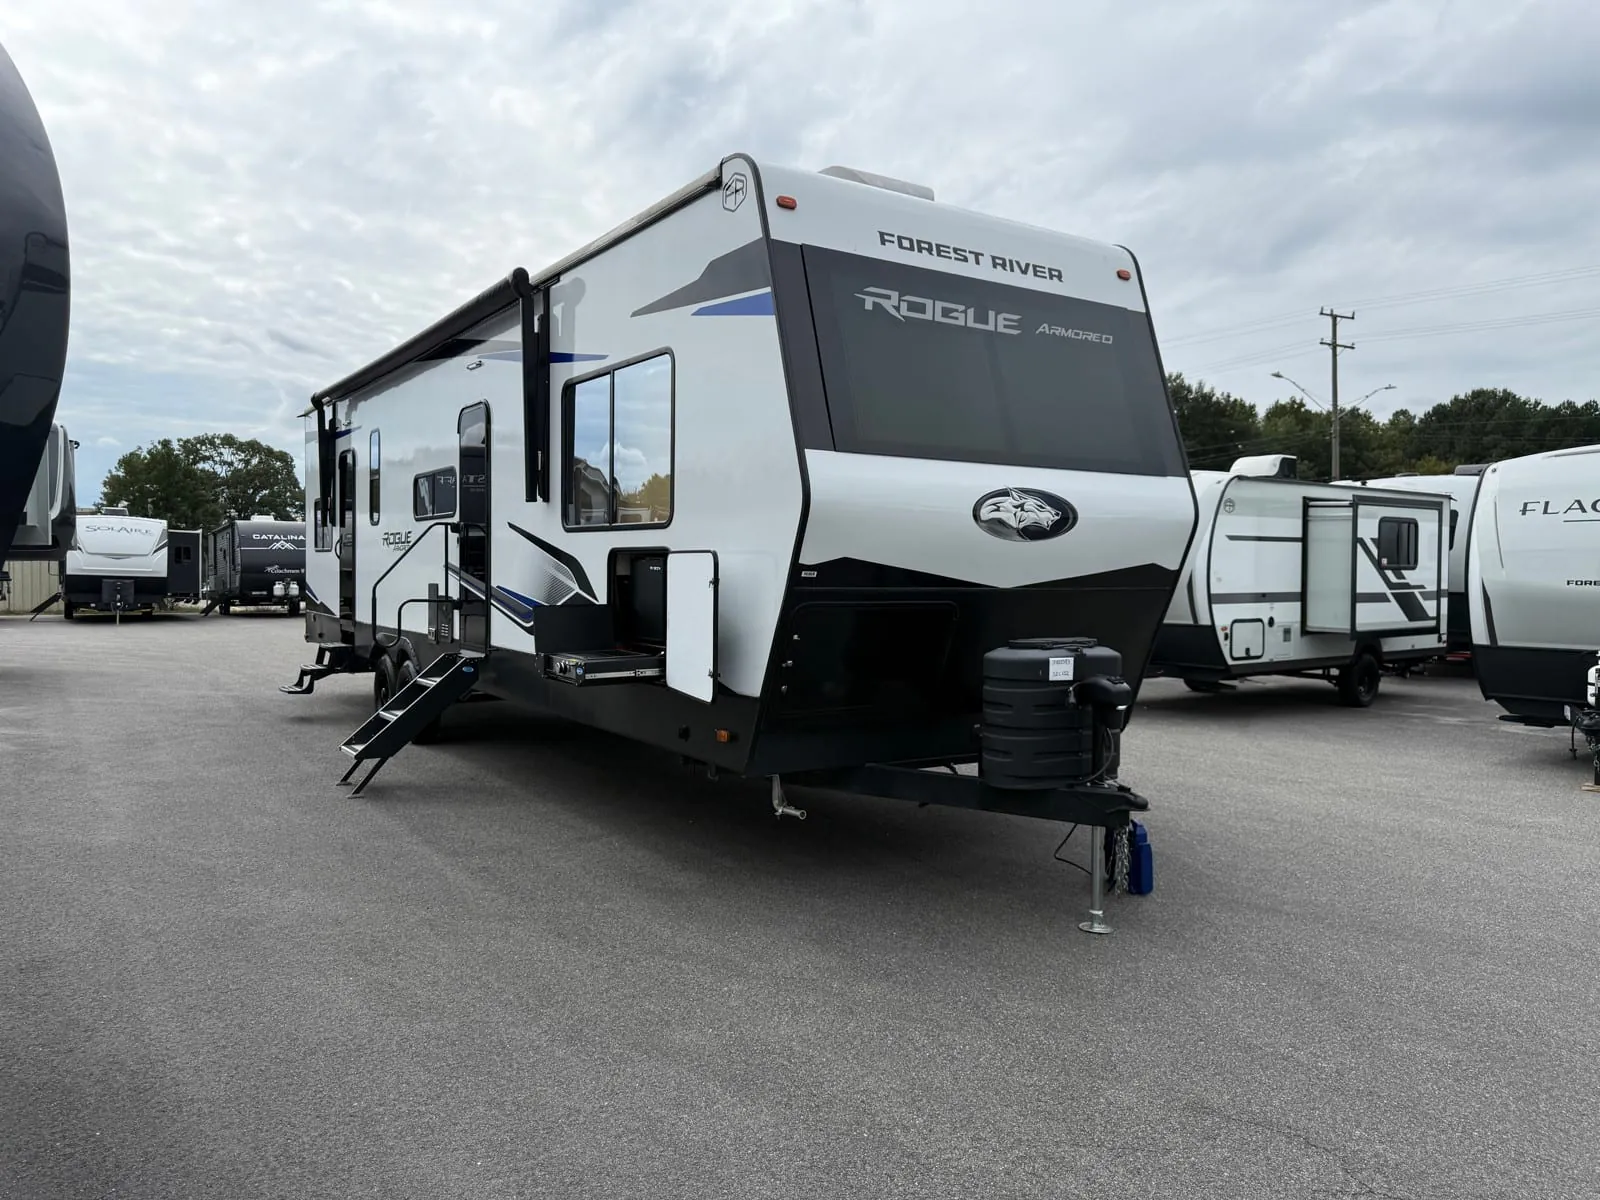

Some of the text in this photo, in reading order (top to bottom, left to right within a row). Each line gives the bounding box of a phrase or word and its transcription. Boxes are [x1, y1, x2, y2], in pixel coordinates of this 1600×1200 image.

[877, 230, 1064, 283] FOREST RIVER
[853, 286, 1023, 336] ROGUE
[1035, 322, 1113, 345] ARMORED
[252, 533, 306, 541] CATALINA
[382, 530, 412, 548] ROGUE
